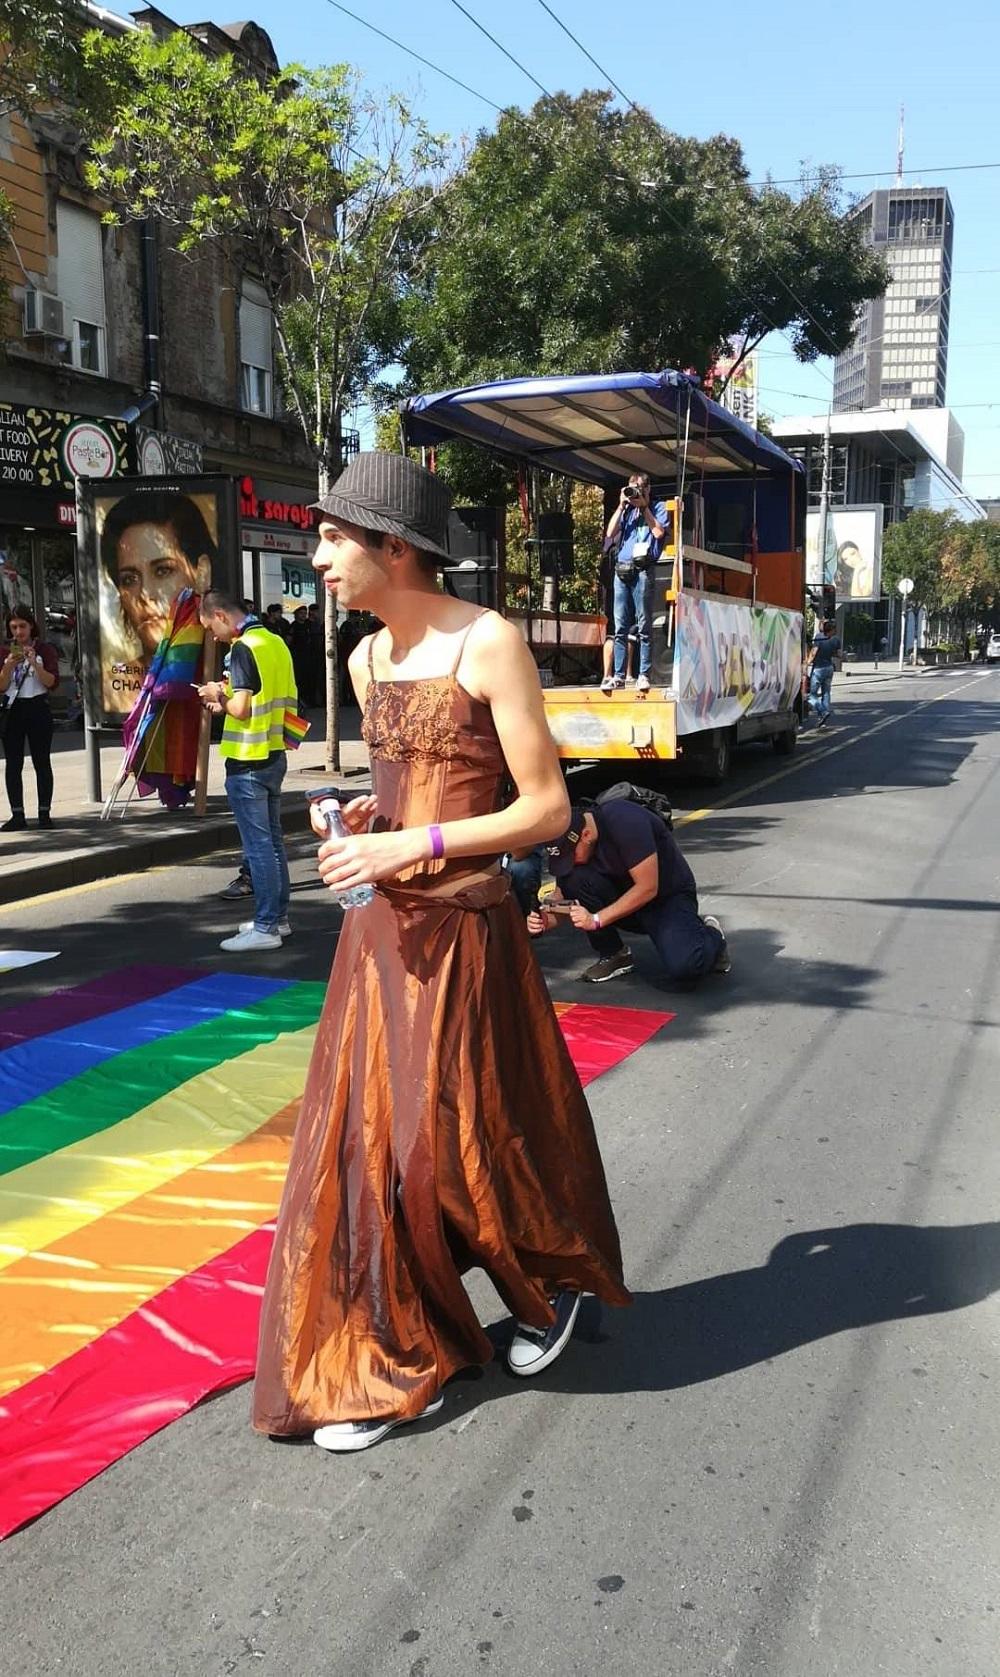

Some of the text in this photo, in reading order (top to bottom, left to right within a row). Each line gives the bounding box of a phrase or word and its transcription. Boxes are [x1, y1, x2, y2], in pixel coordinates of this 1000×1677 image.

[0, 411, 25, 426] LIAN
[7, 430, 31, 445] FOOD
[2, 466, 34, 482] 210 010
[112, 679, 142, 691] CHA
